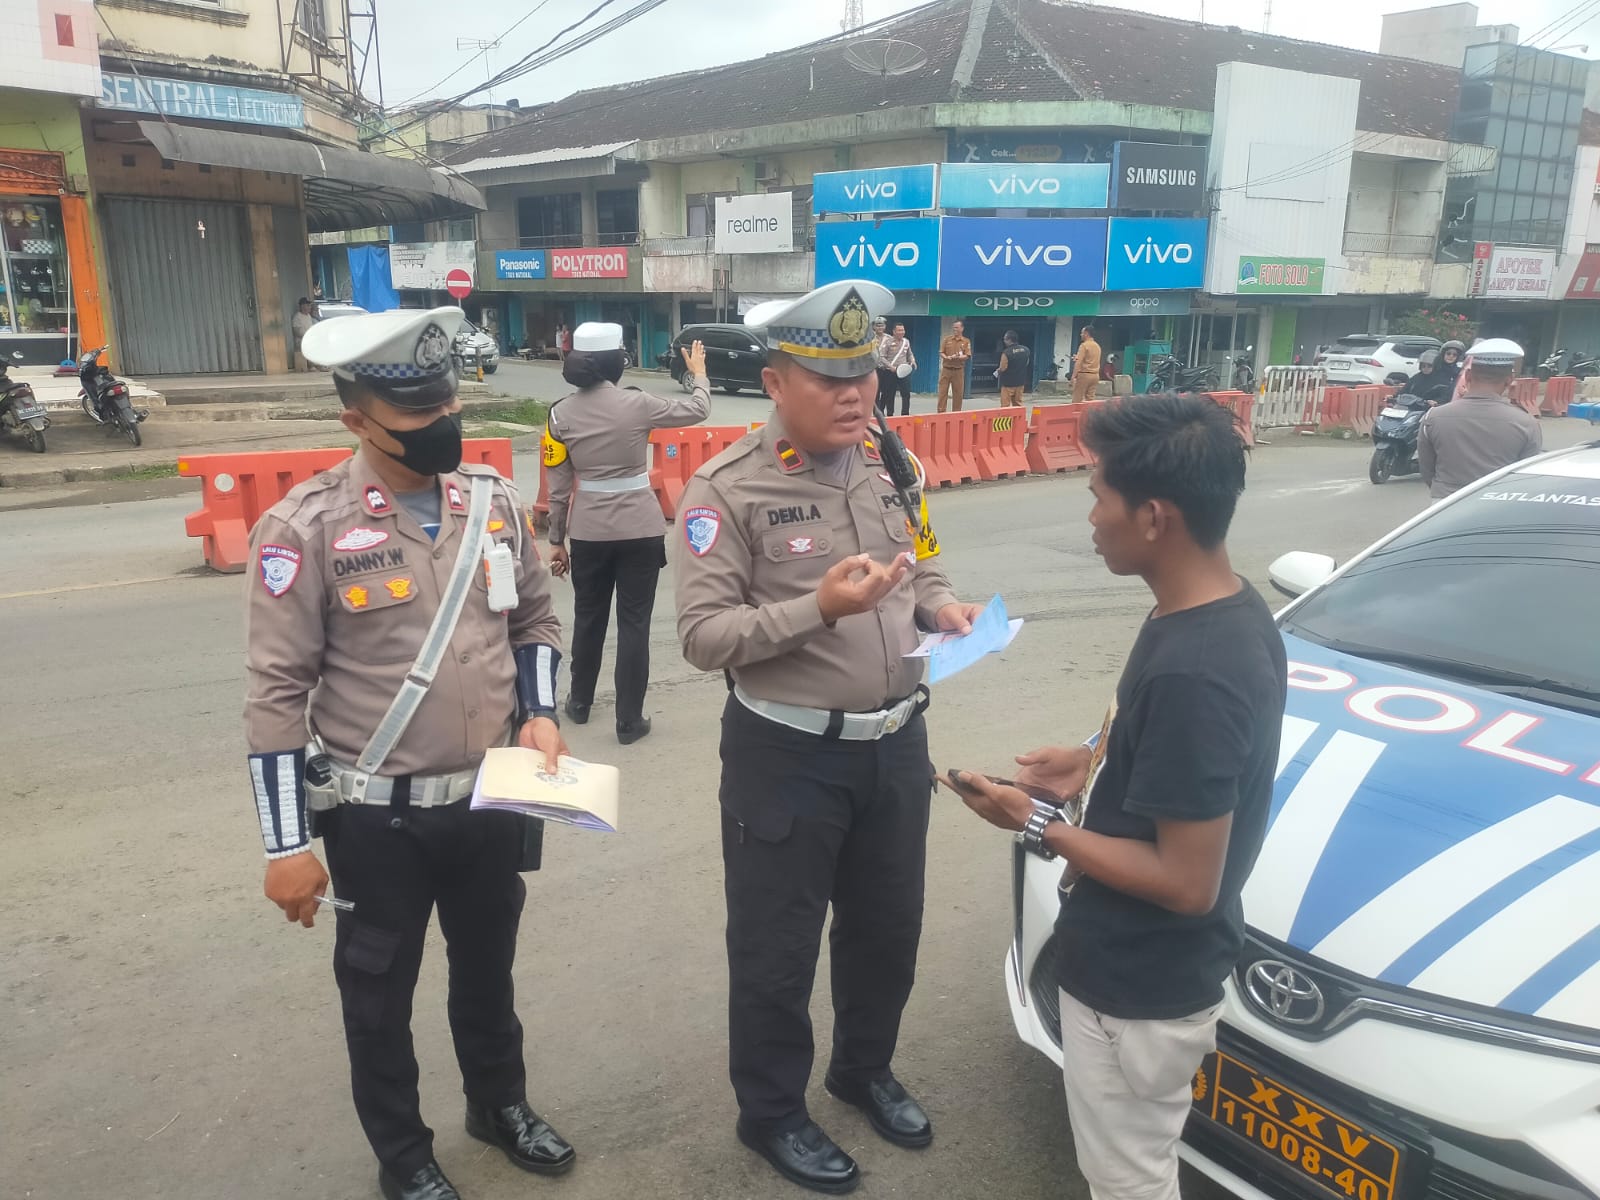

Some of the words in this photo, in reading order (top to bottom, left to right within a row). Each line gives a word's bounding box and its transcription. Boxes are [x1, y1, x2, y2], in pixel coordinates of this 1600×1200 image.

[98, 74, 229, 117] SENTRAL
[228, 95, 301, 126] ELECTRONIK
[988, 174, 1061, 195] vivo
[1126, 166, 1197, 186] SAMSUNG
[844, 179, 897, 200] vivo
[727, 215, 778, 234] realme
[832, 235, 920, 268] vivo
[974, 237, 1072, 266] vivo
[1124, 236, 1193, 264] vivo
[500, 258, 540, 271] Panasonic
[553, 253, 625, 272] POLYTRON
[1259, 264, 1283, 286] FOTO
[1285, 264, 1309, 286] SOLO
[974, 296, 1054, 311] oppo
[1130, 297, 1160, 309] oppo
[1480, 491, 1600, 507] SATLANTAS
[767, 504, 822, 527] DEKI.A
[334, 547, 405, 577] DANNY.W
[1222, 1100, 1379, 1200] 11008-40
